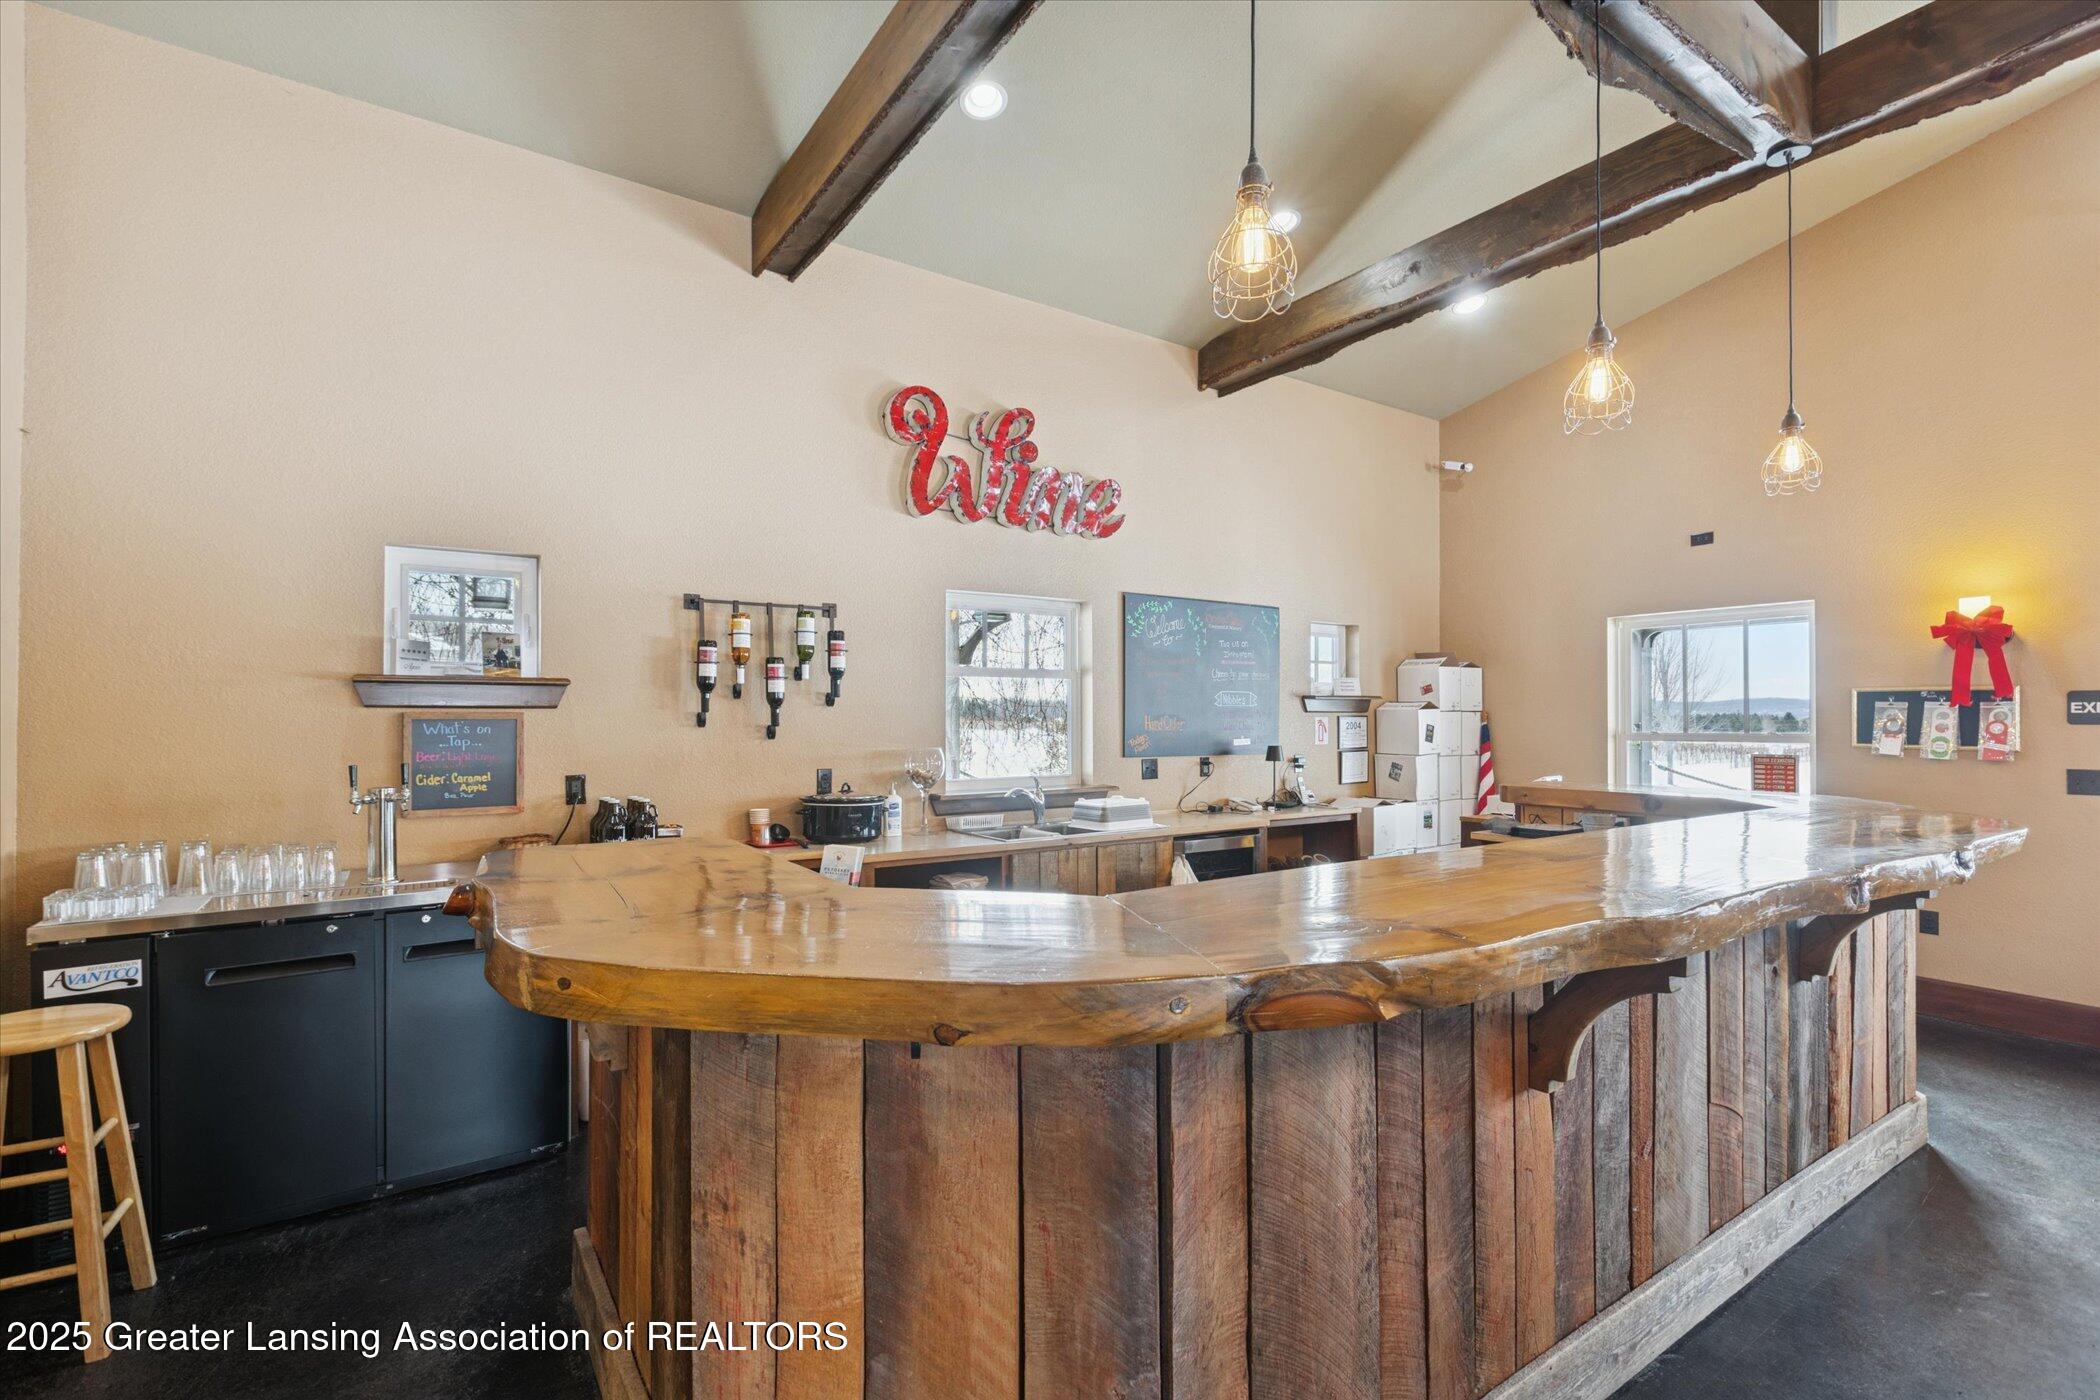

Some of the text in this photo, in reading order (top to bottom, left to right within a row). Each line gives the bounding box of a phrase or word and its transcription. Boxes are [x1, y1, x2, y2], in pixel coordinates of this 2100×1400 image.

[1145, 614, 1186, 639] Welcome
[422, 721, 470, 735] What's
[1346, 722, 1362, 730] 2004
[451, 772, 492, 784] Caramel
[460, 784, 487, 792] Apple
[47, 967, 138, 991] AVANTCO
